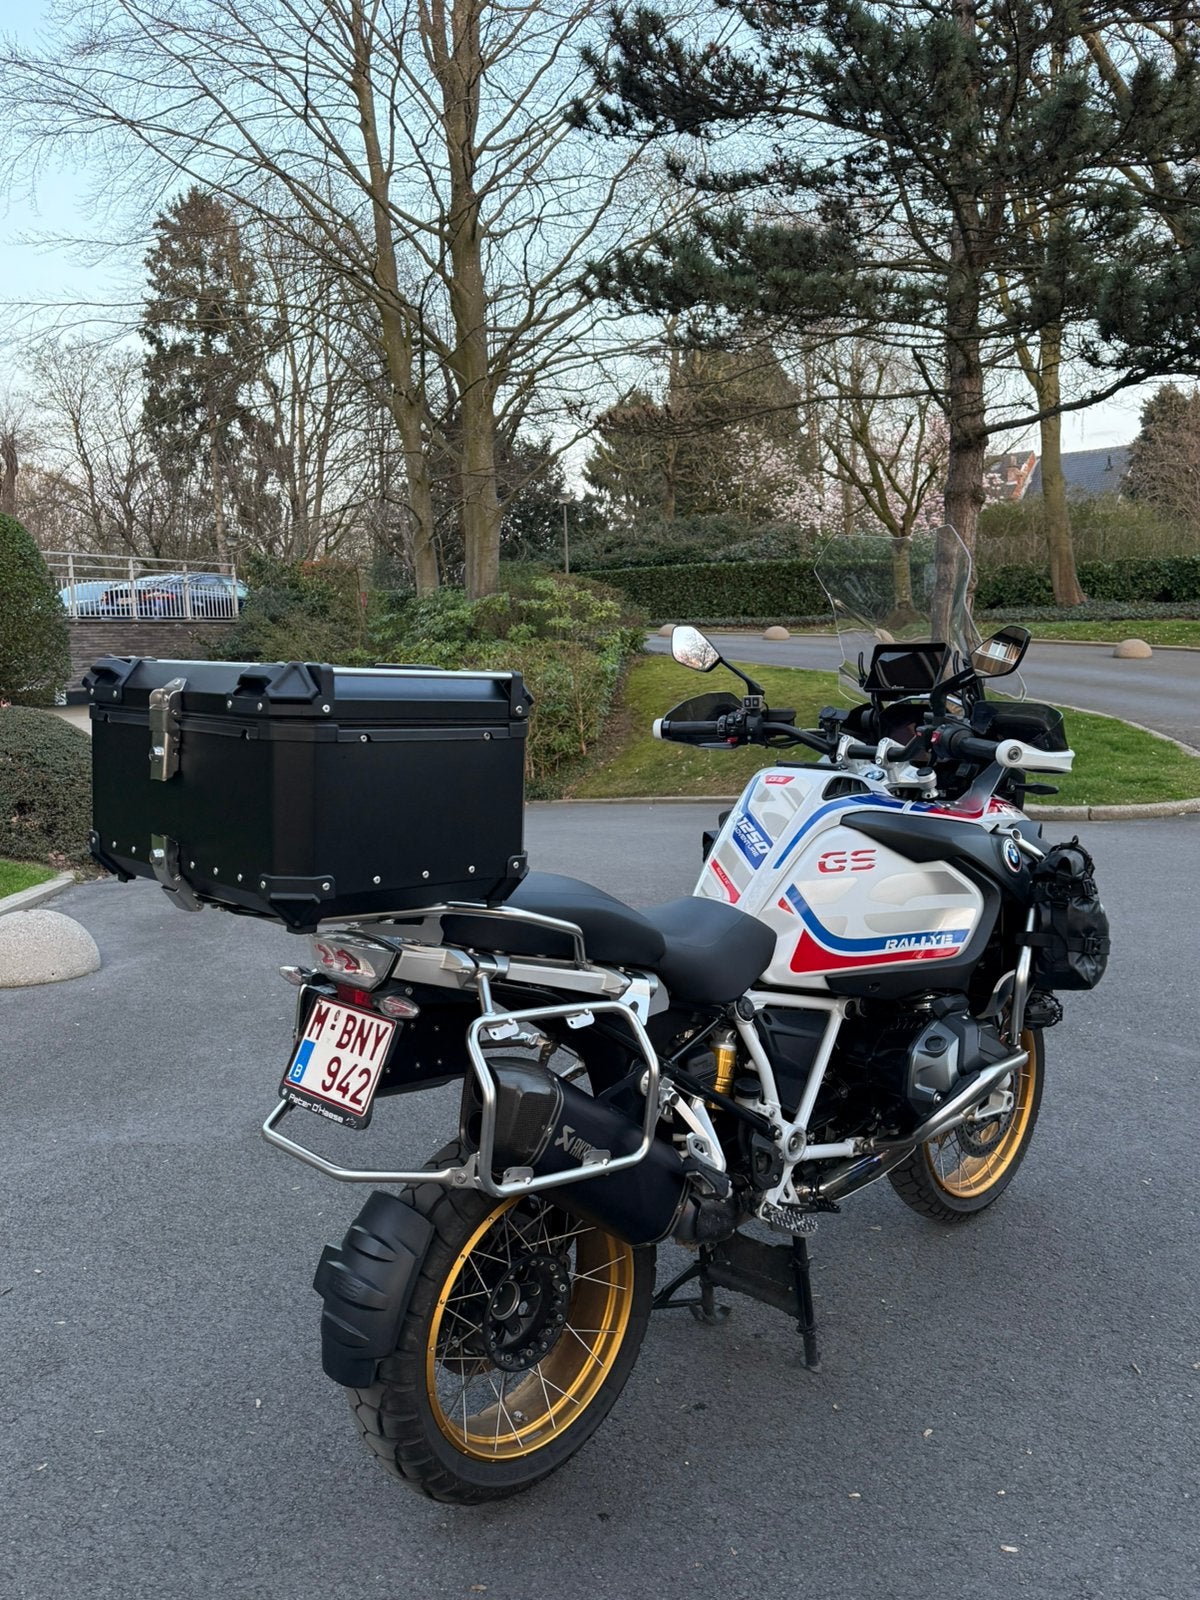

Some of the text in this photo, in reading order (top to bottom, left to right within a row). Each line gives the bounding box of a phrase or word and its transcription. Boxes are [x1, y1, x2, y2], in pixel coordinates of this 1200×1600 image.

[736, 816, 771, 855] 1250
[818, 849, 877, 873] GS
[885, 934, 953, 950] RALLYE
[293, 1065, 303, 1077] B
[321, 1056, 371, 1106] 942
[289, 1094, 311, 1107] Peter
